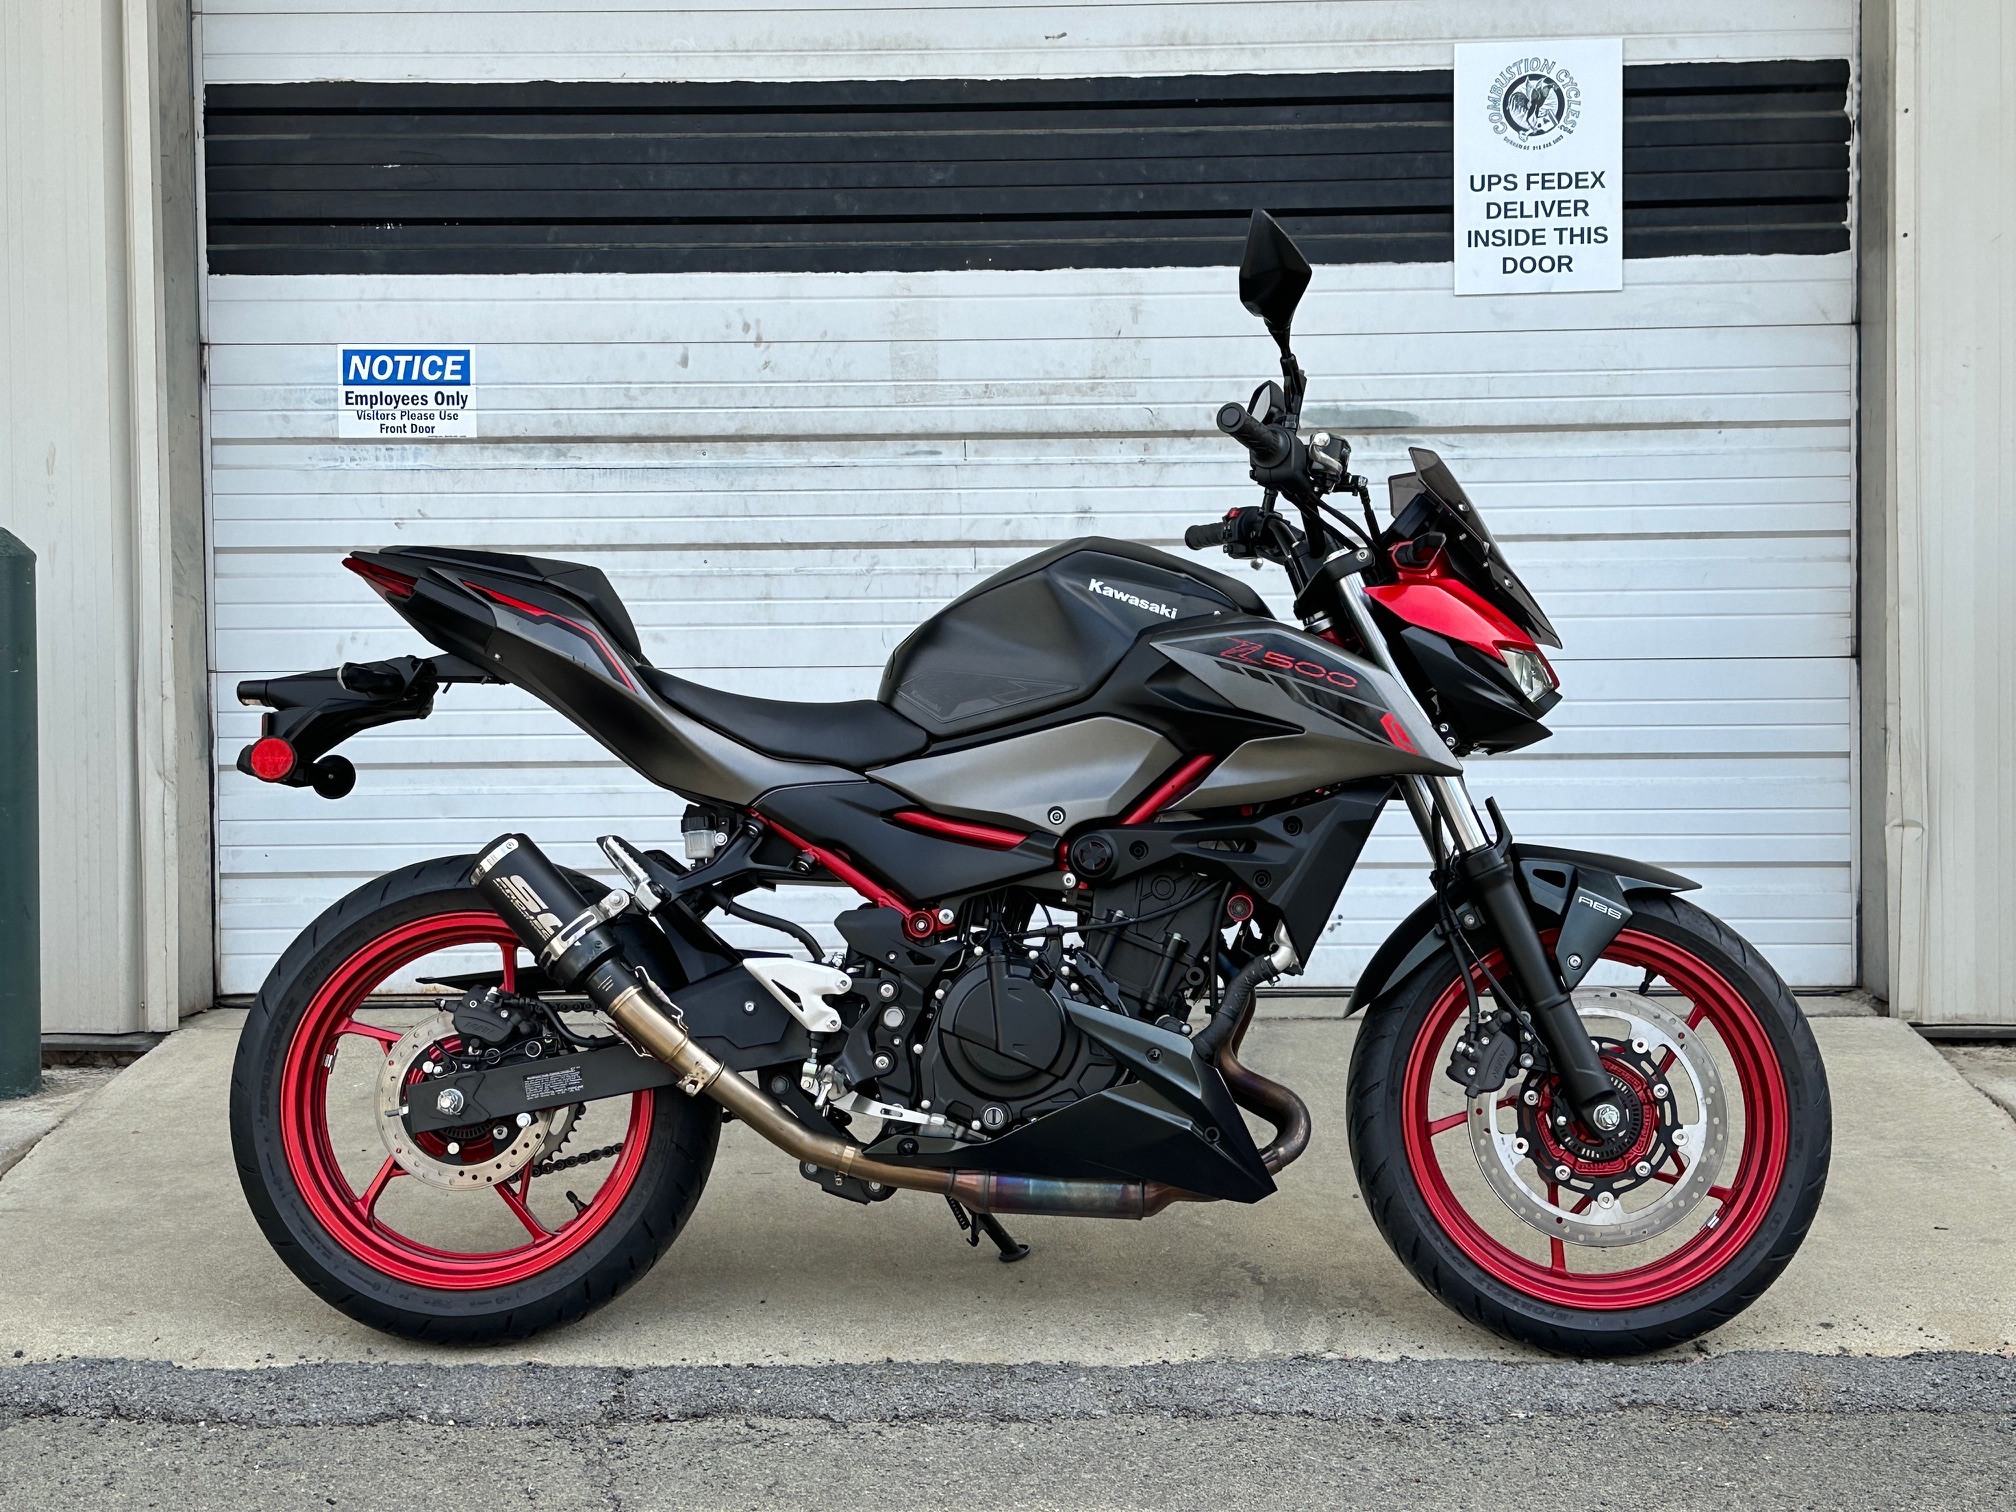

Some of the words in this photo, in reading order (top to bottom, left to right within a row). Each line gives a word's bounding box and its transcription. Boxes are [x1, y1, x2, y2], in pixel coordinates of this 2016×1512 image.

[1487, 57, 1556, 134] COMBUSTION
[1555, 68, 1581, 128] CYCLES
[1470, 174, 1518, 193] UPS
[1526, 171, 1606, 191] FEDEX
[1486, 199, 1589, 220] DELIVER
[1467, 228, 1546, 248] INSIDE
[1554, 226, 1609, 245] THIS
[1502, 254, 1573, 274] DOOR
[348, 355, 465, 381] NOTICE
[345, 391, 428, 410] Employees
[434, 391, 468, 409] Only
[356, 410, 396, 421] Visitors
[400, 410, 435, 421] Please
[439, 410, 459, 421] Use
[379, 423, 407, 434] Front
[410, 423, 436, 434] Door
[1088, 578, 1178, 619] Kawasaki
[1578, 896, 1622, 920] ABS
